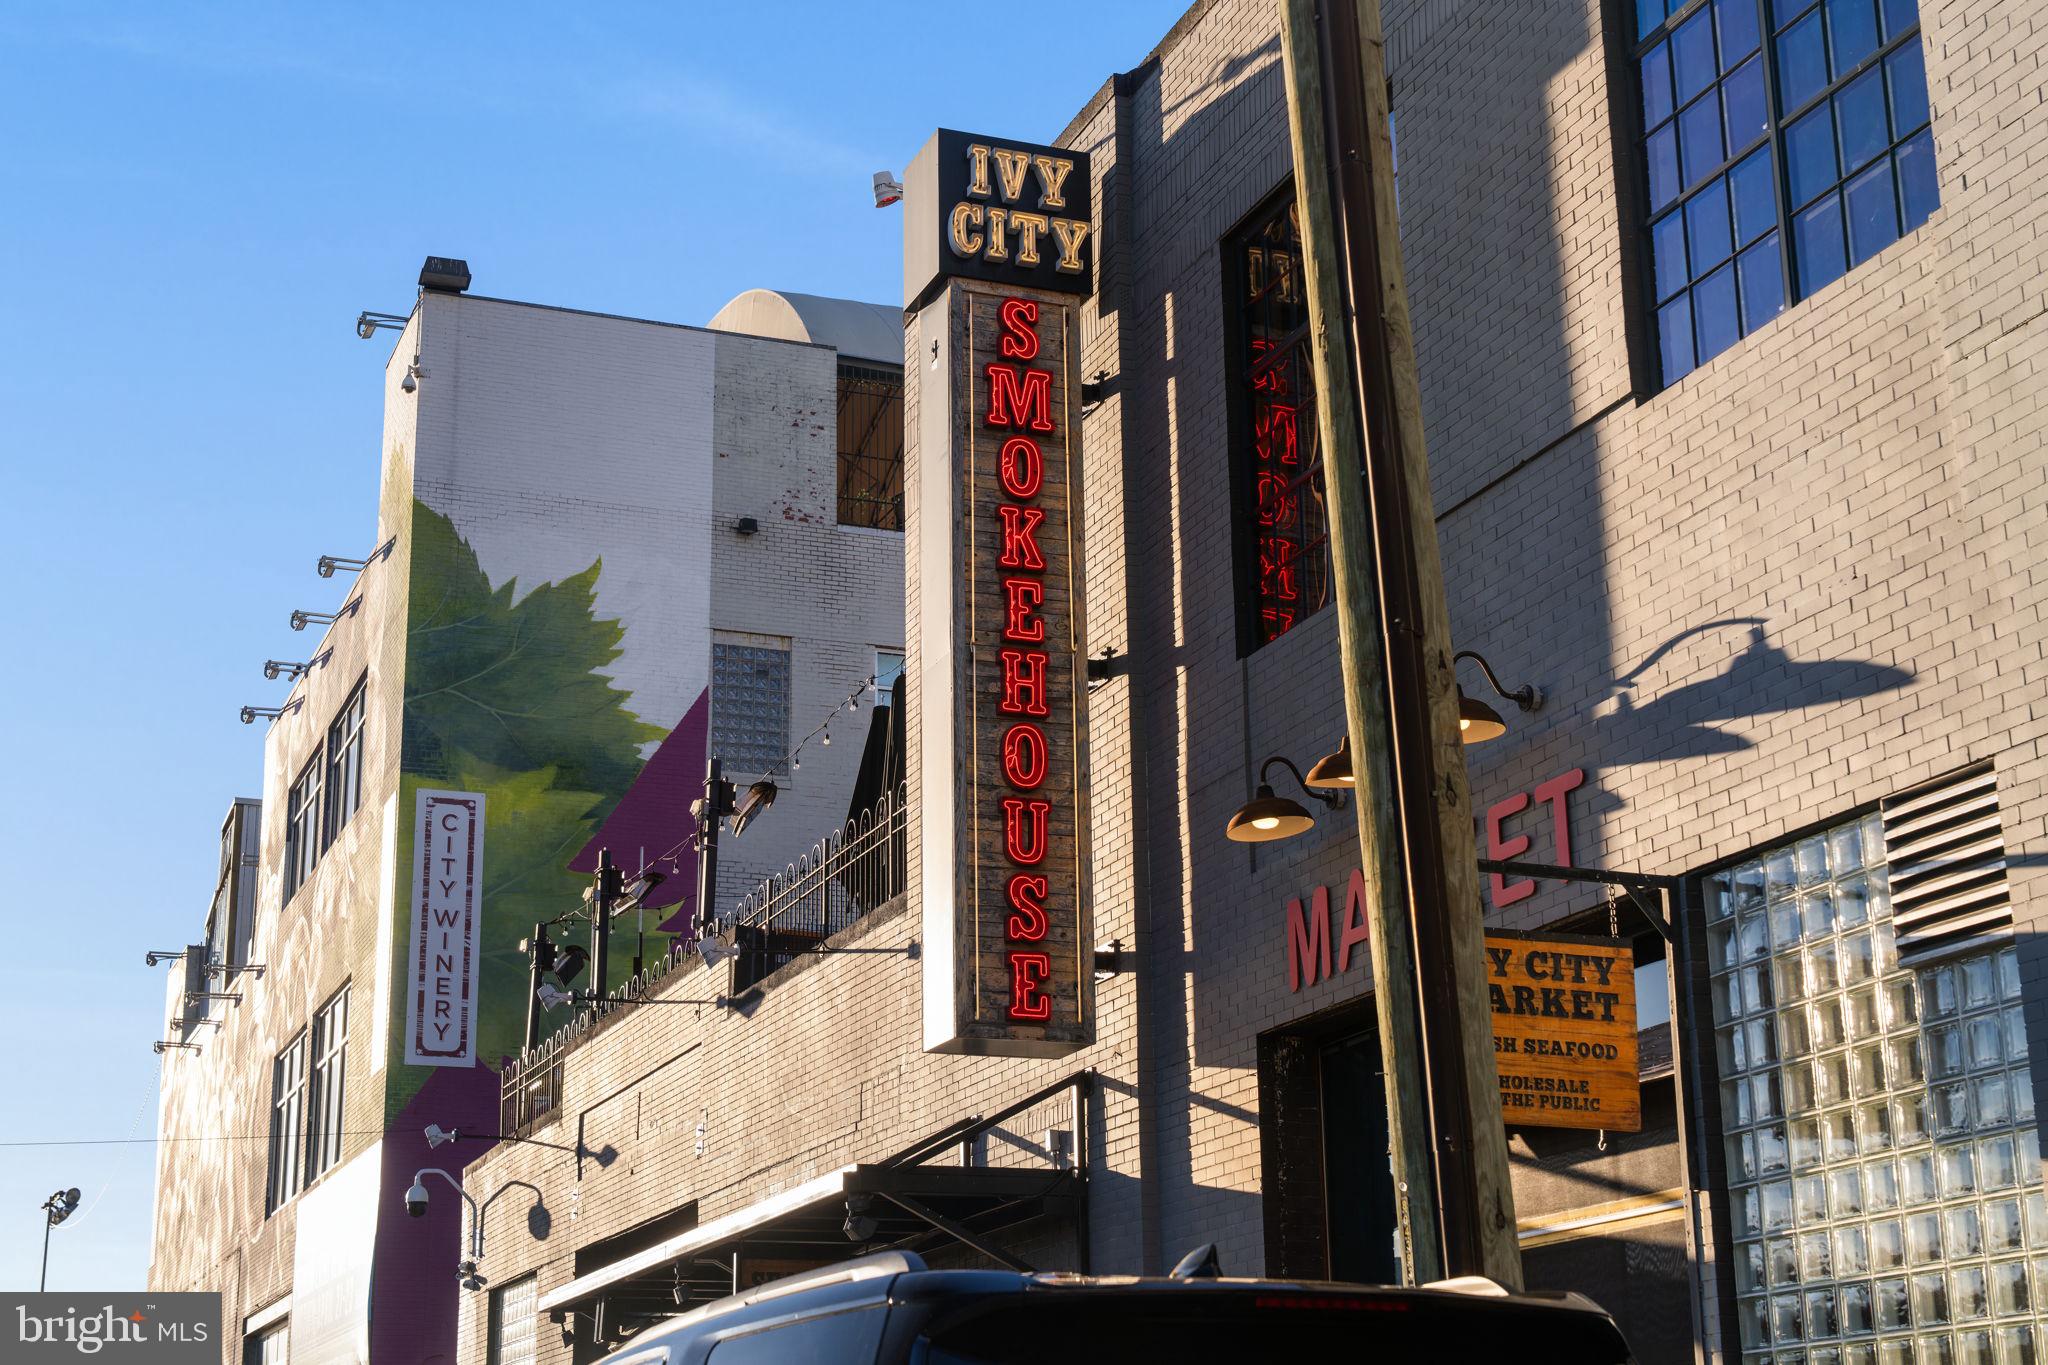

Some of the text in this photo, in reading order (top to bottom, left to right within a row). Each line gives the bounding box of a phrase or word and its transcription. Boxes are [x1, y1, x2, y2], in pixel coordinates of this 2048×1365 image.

[966, 143, 1073, 211] IVY
[948, 202, 1091, 275] CITY
[984, 296, 1055, 1022] SMOKEHOUSE
[1287, 767, 1584, 993] MAET
[433, 813, 460, 1041] CITY WINERY
[1525, 951, 1615, 986] CITY
[1488, 984, 1619, 1022] ARKET
[1524, 1038, 1618, 1060] SEAFOOD
[1498, 1074, 1589, 1094] HOLESALE
[1500, 1092, 1600, 1112] THE PUBLIC
